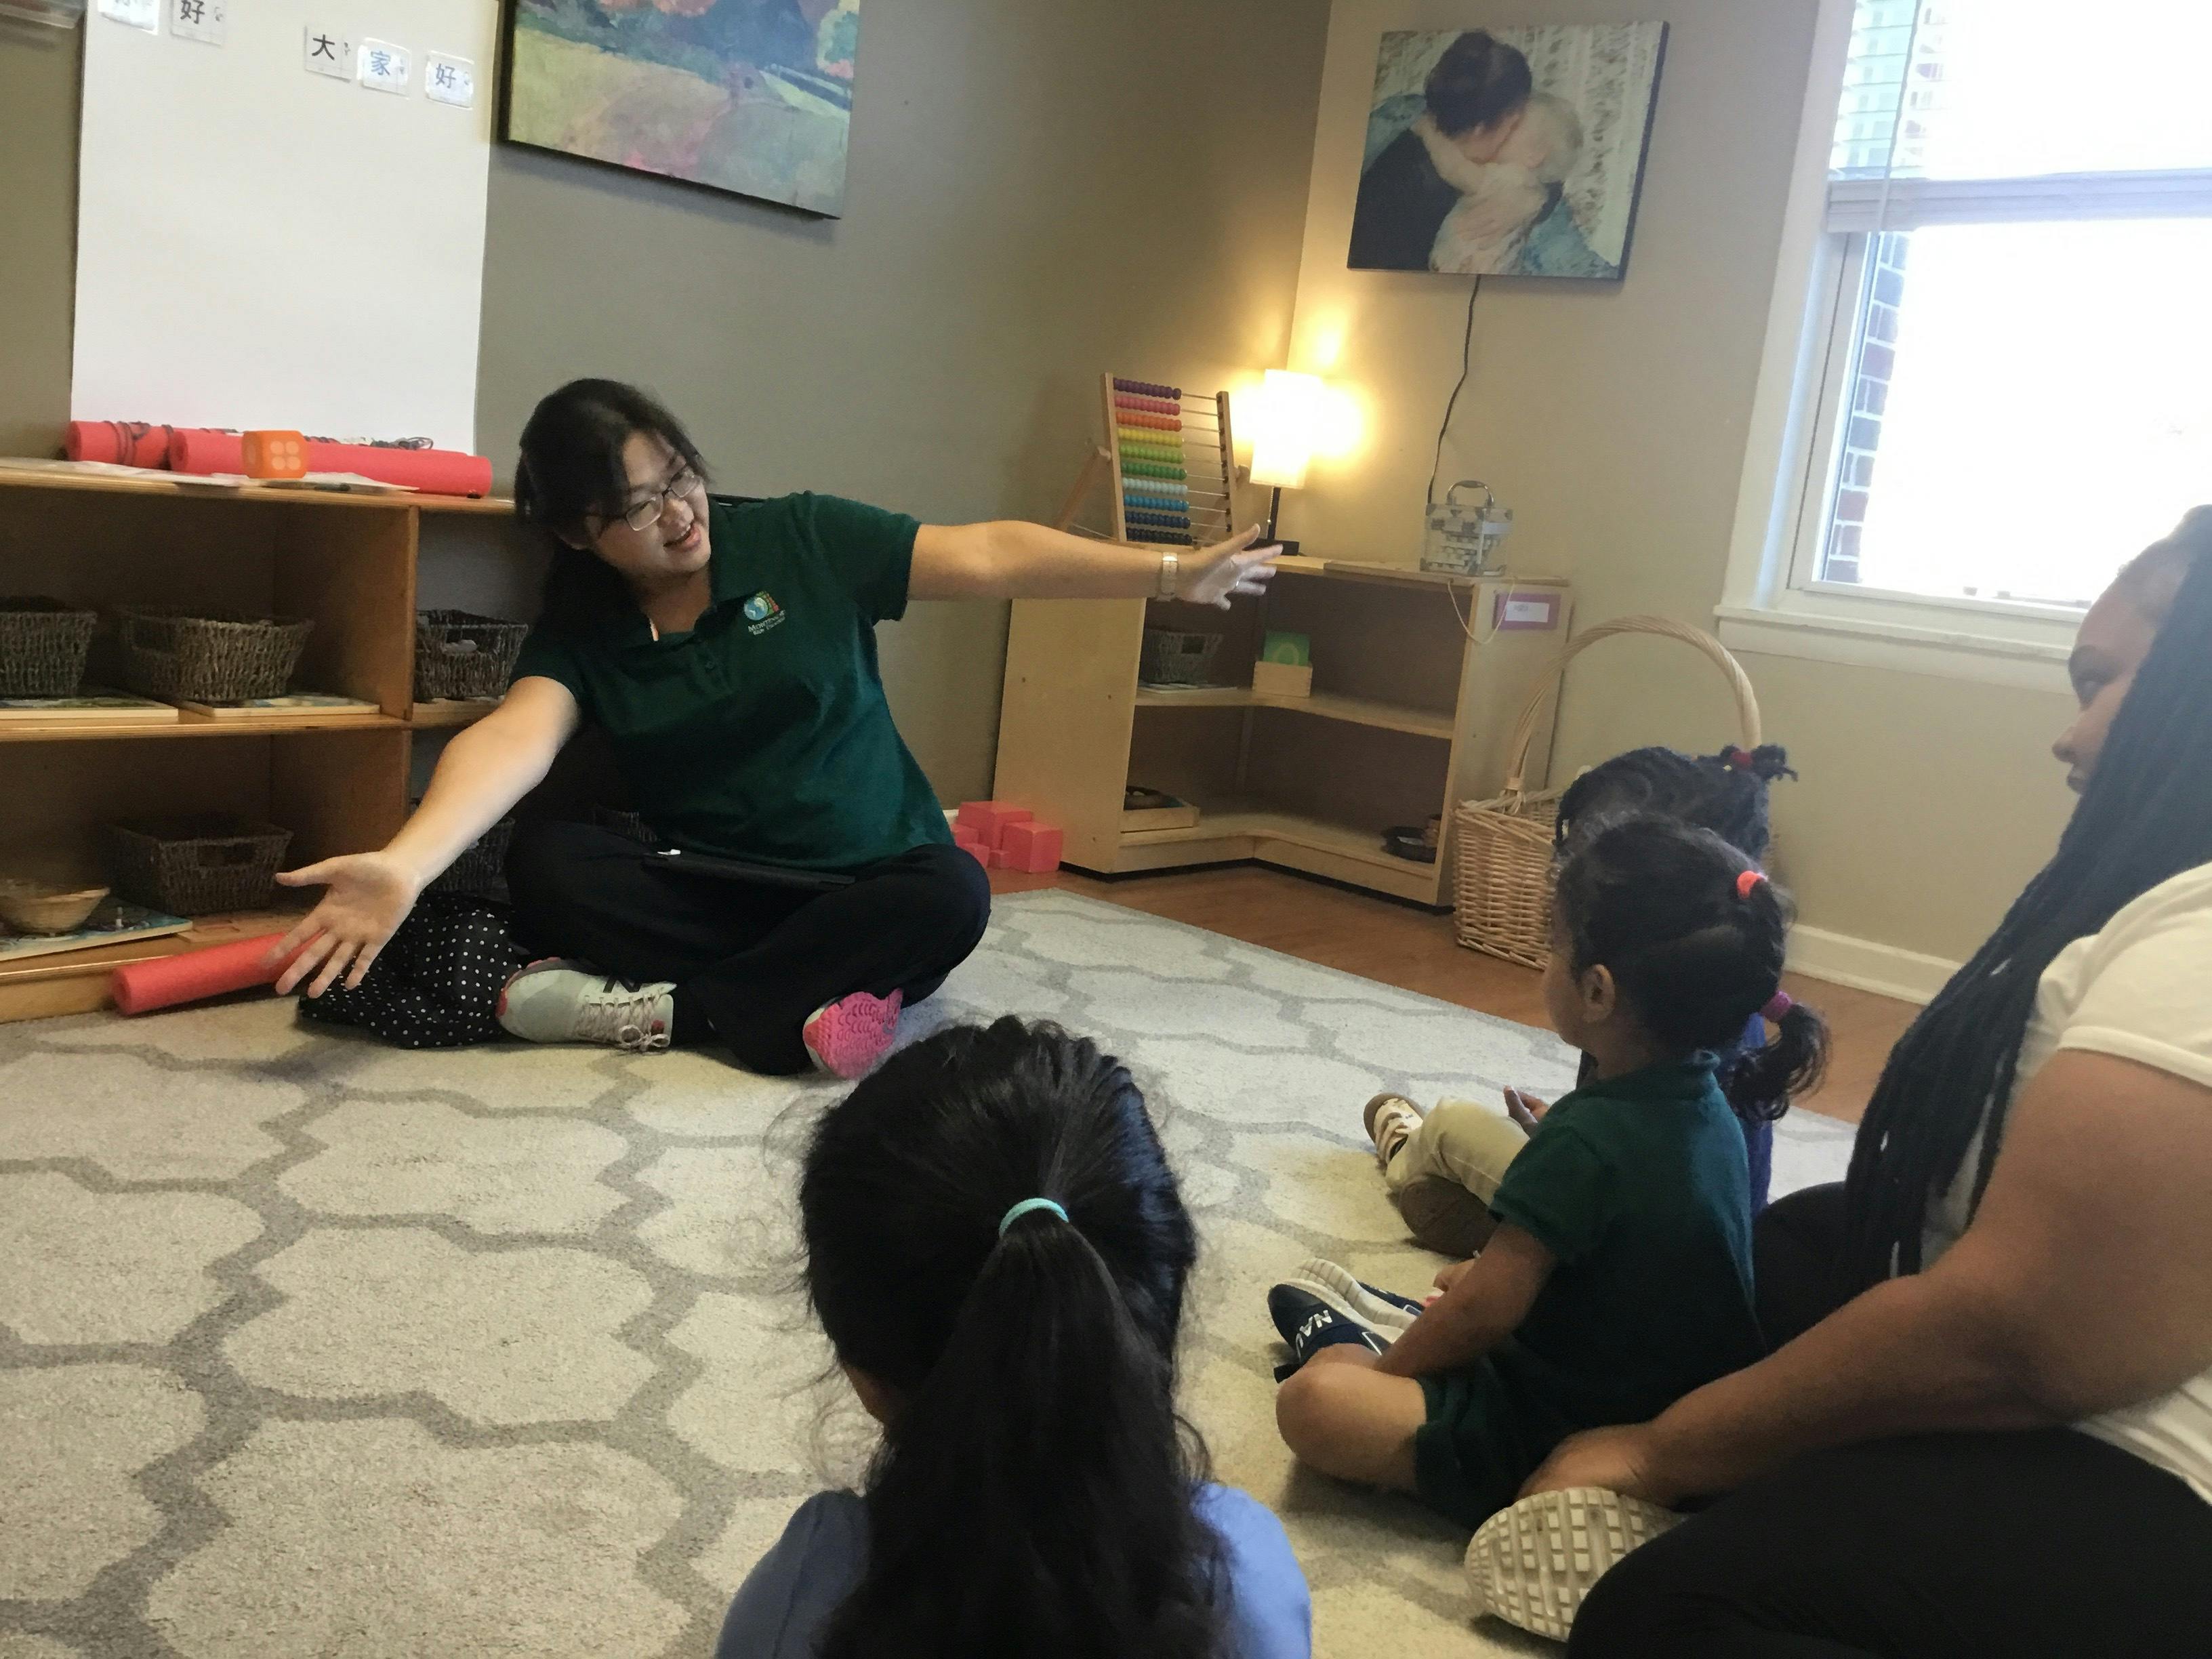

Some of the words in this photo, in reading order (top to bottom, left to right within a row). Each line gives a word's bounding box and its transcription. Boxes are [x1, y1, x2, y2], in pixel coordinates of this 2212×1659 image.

[180, 0, 205, 24] 好
[311, 34, 335, 60] 大
[370, 50, 391, 76] 家
[435, 63, 456, 89] 好
